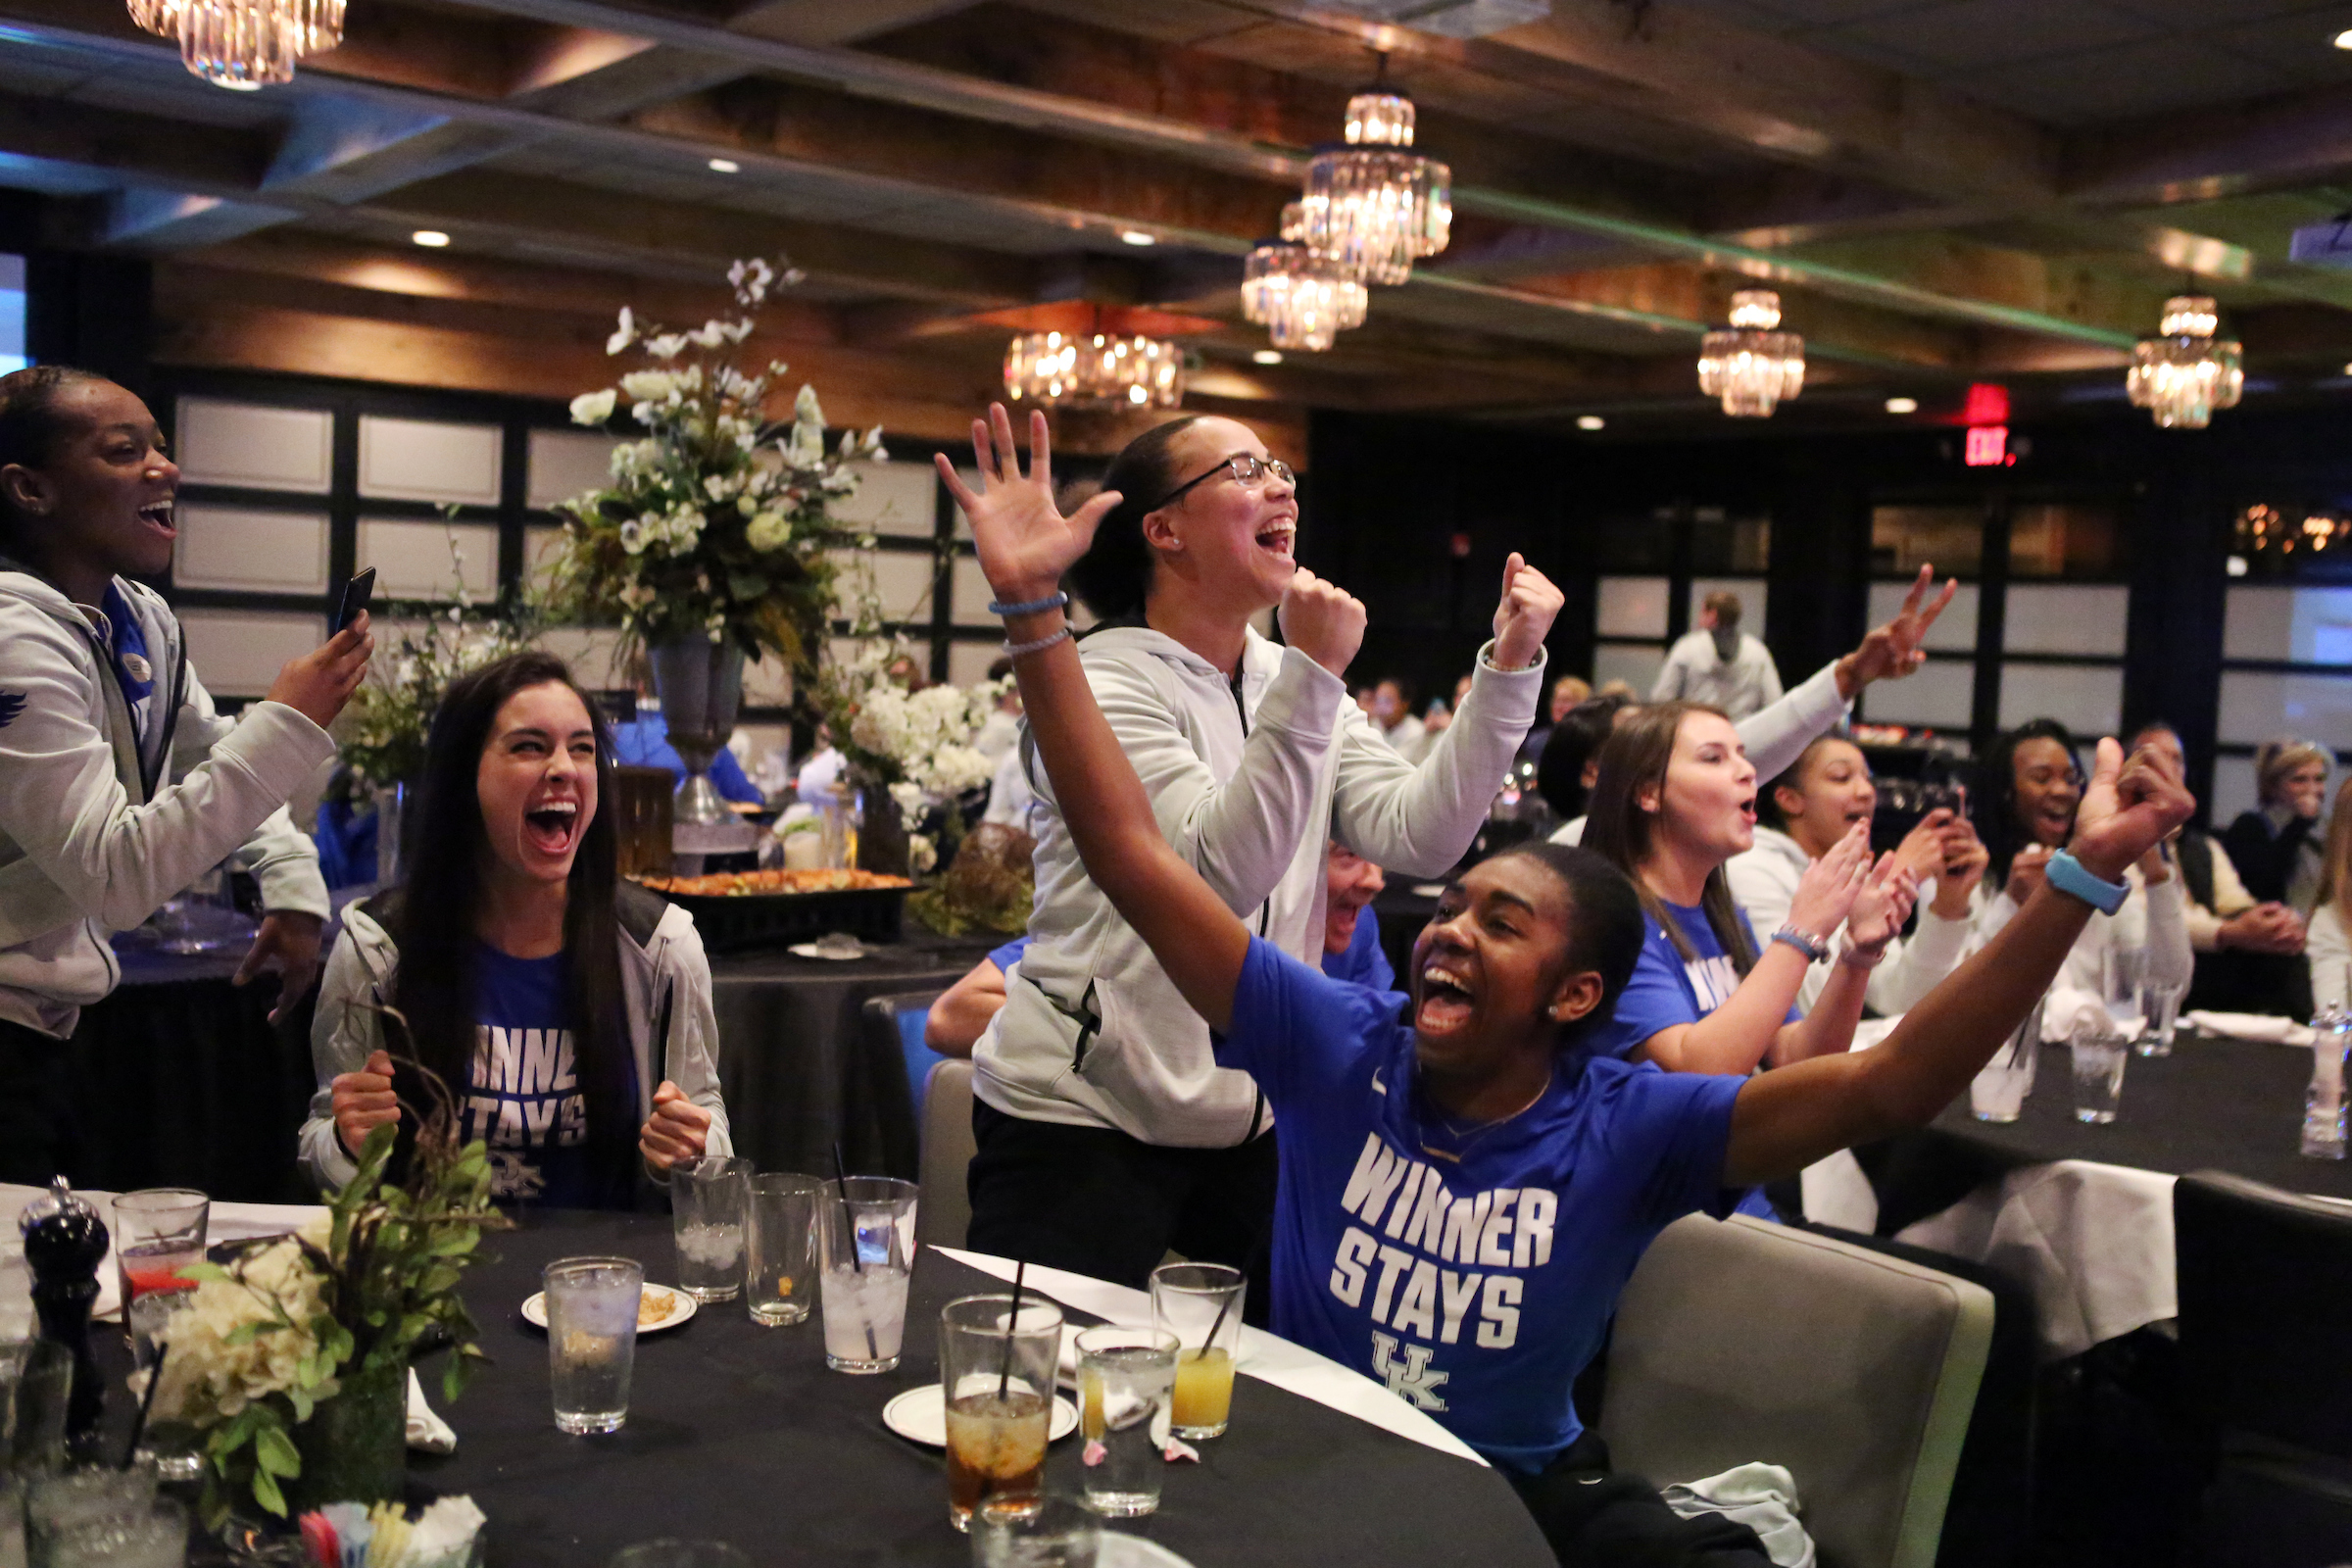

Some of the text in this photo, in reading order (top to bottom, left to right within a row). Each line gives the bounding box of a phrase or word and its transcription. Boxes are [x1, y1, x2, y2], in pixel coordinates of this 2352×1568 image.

[471, 1024, 576, 1096] INNE
[459, 1094, 586, 1148] TAYS
[1341, 1131, 1558, 1268] WINNER
[1330, 1227, 1524, 1349] STAYS
[1372, 1330, 1448, 1411] UK
